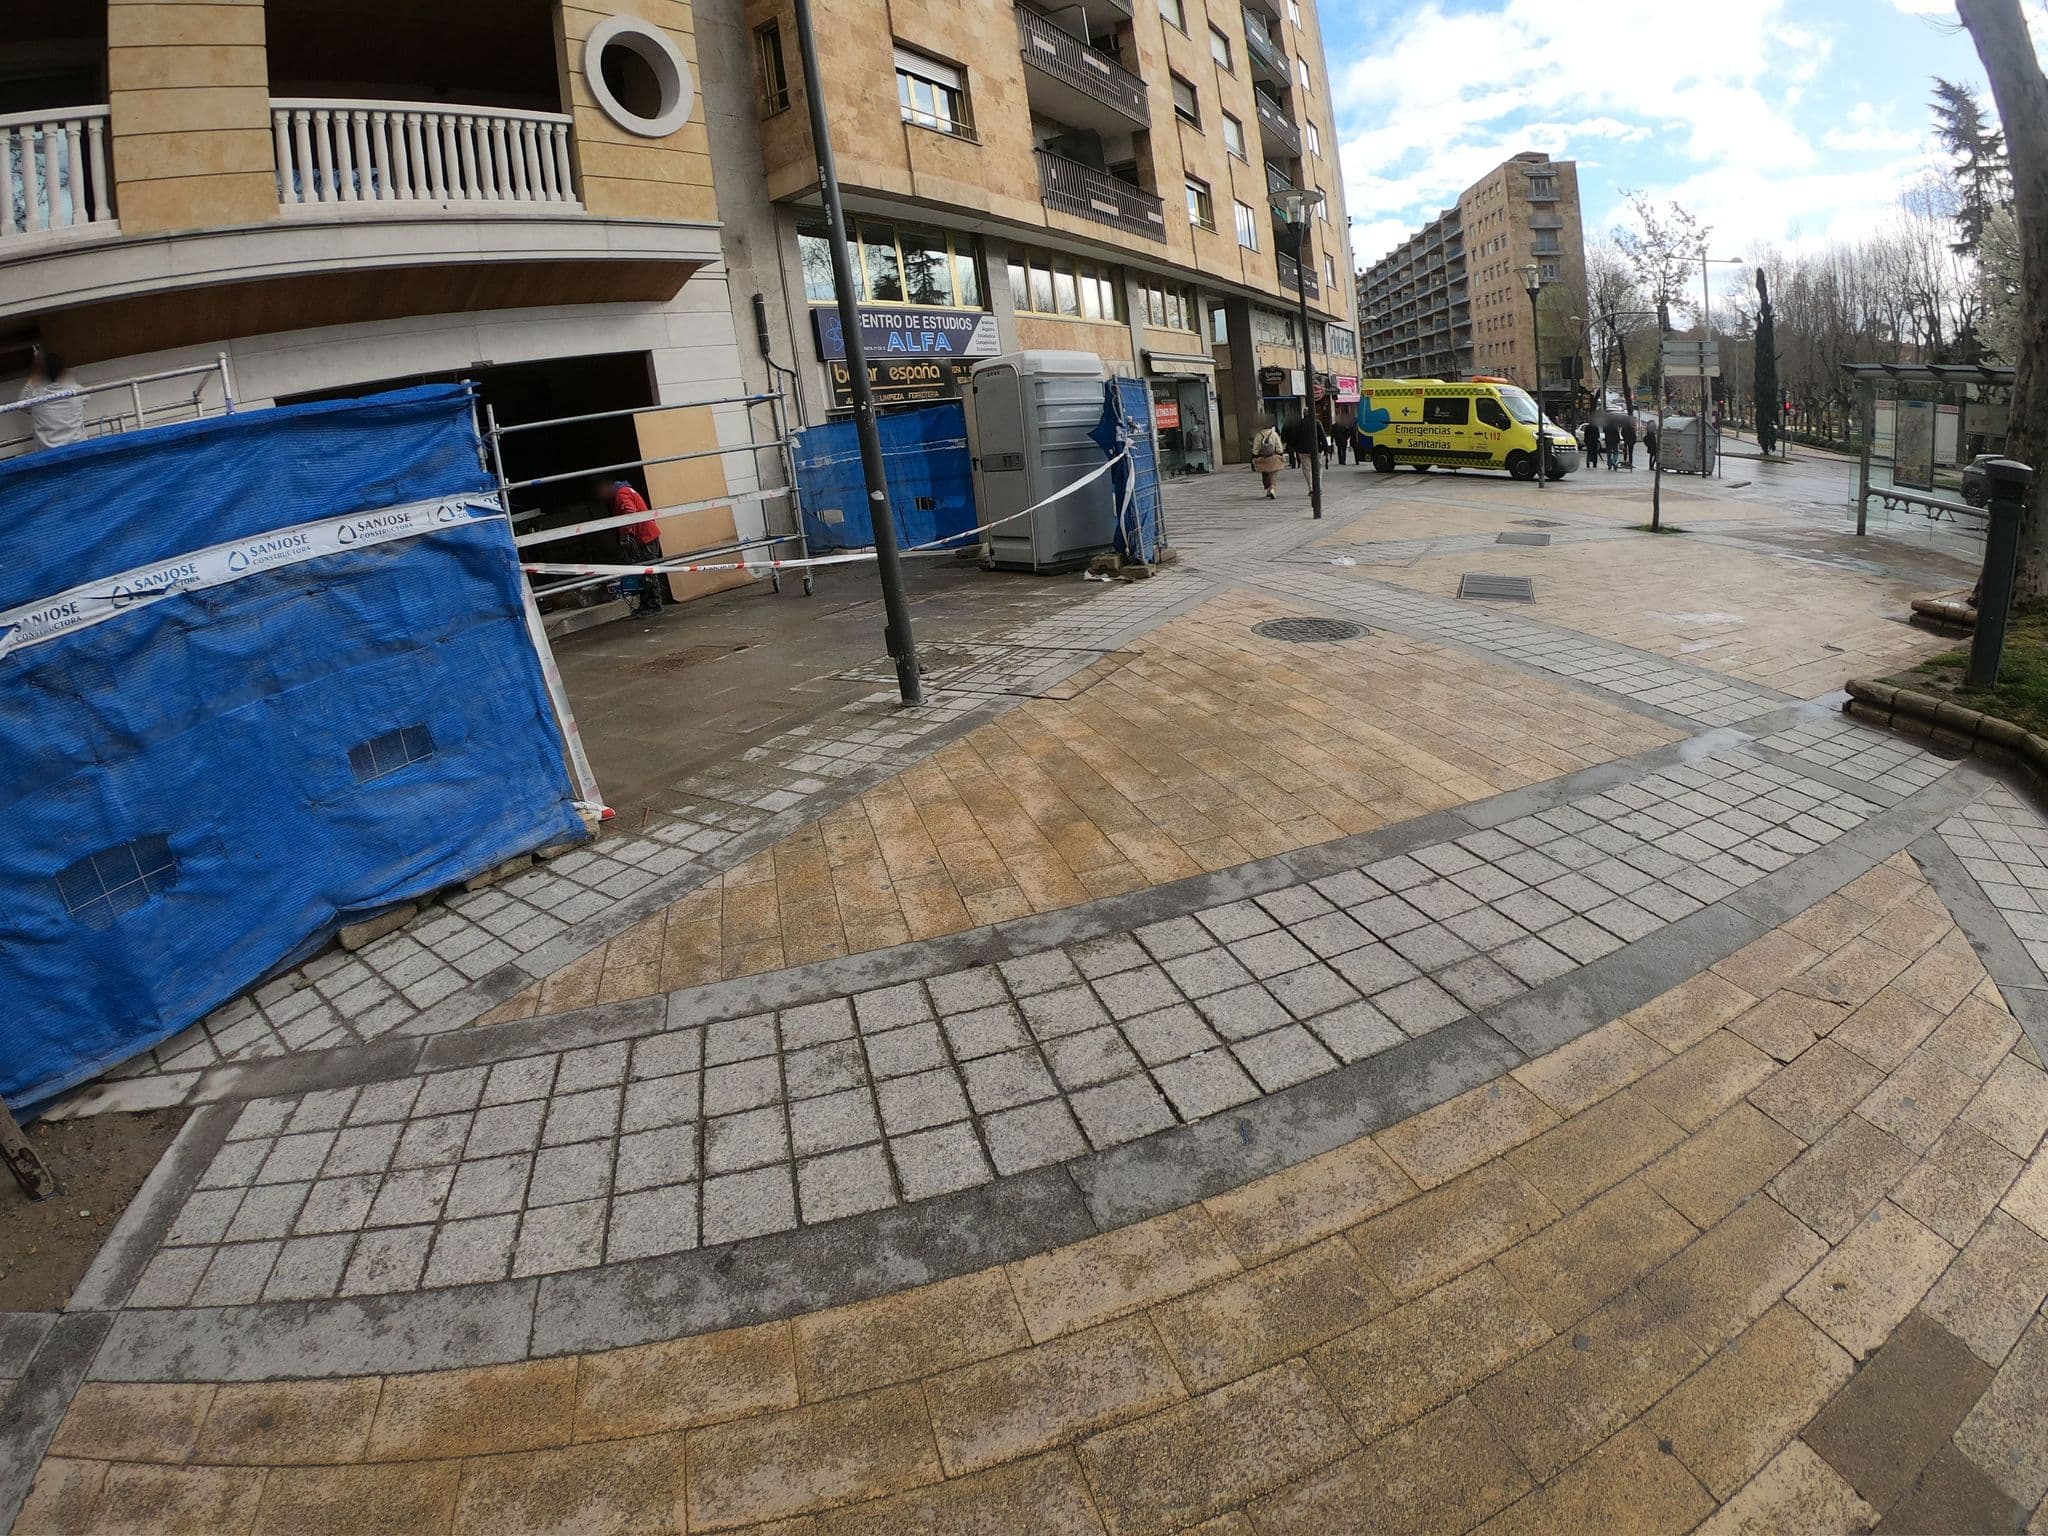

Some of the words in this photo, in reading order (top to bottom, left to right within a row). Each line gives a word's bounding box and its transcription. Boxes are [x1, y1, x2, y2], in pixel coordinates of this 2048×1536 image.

[905, 315, 921, 329] DE
[922, 315, 973, 331] ESTUDIOS
[886, 331, 953, 352] ALFA
[833, 363, 878, 384] bar
[888, 362, 941, 385] españa
[1395, 424, 1452, 437] Emergencias
[1490, 431, 1501, 441] 112
[1408, 438, 1451, 449] Sanitarias
[357, 512, 412, 533] SANJOSE
[359, 523, 414, 540] CONSTRUCTORA
[249, 533, 310, 558] SANJOSE
[252, 546, 312, 565] CONSTRUCTORA
[134, 562, 198, 591] SANJOSE
[15, 615, 83, 643] CONUCTORA
